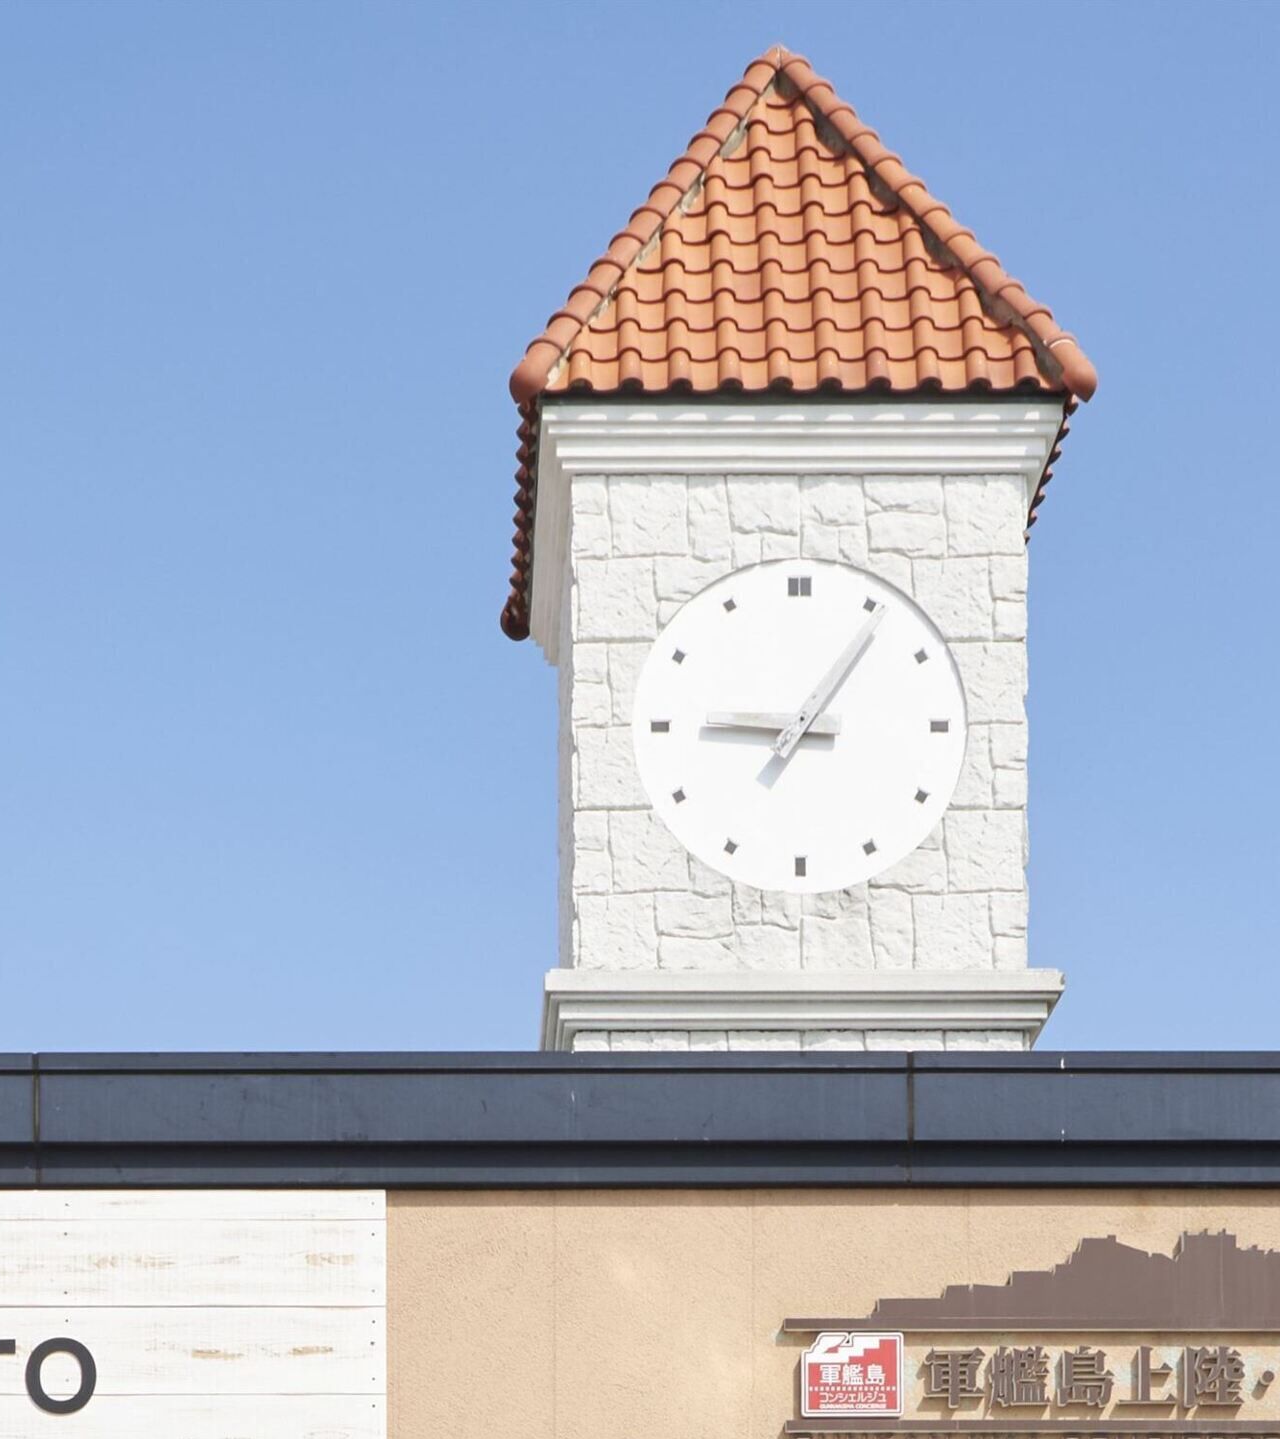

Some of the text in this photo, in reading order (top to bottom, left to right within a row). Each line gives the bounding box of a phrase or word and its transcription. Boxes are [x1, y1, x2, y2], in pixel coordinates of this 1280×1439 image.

[819, 1363, 887, 1386] 軍艦島
[819, 1391, 887, 1403] コンシェルジュ
